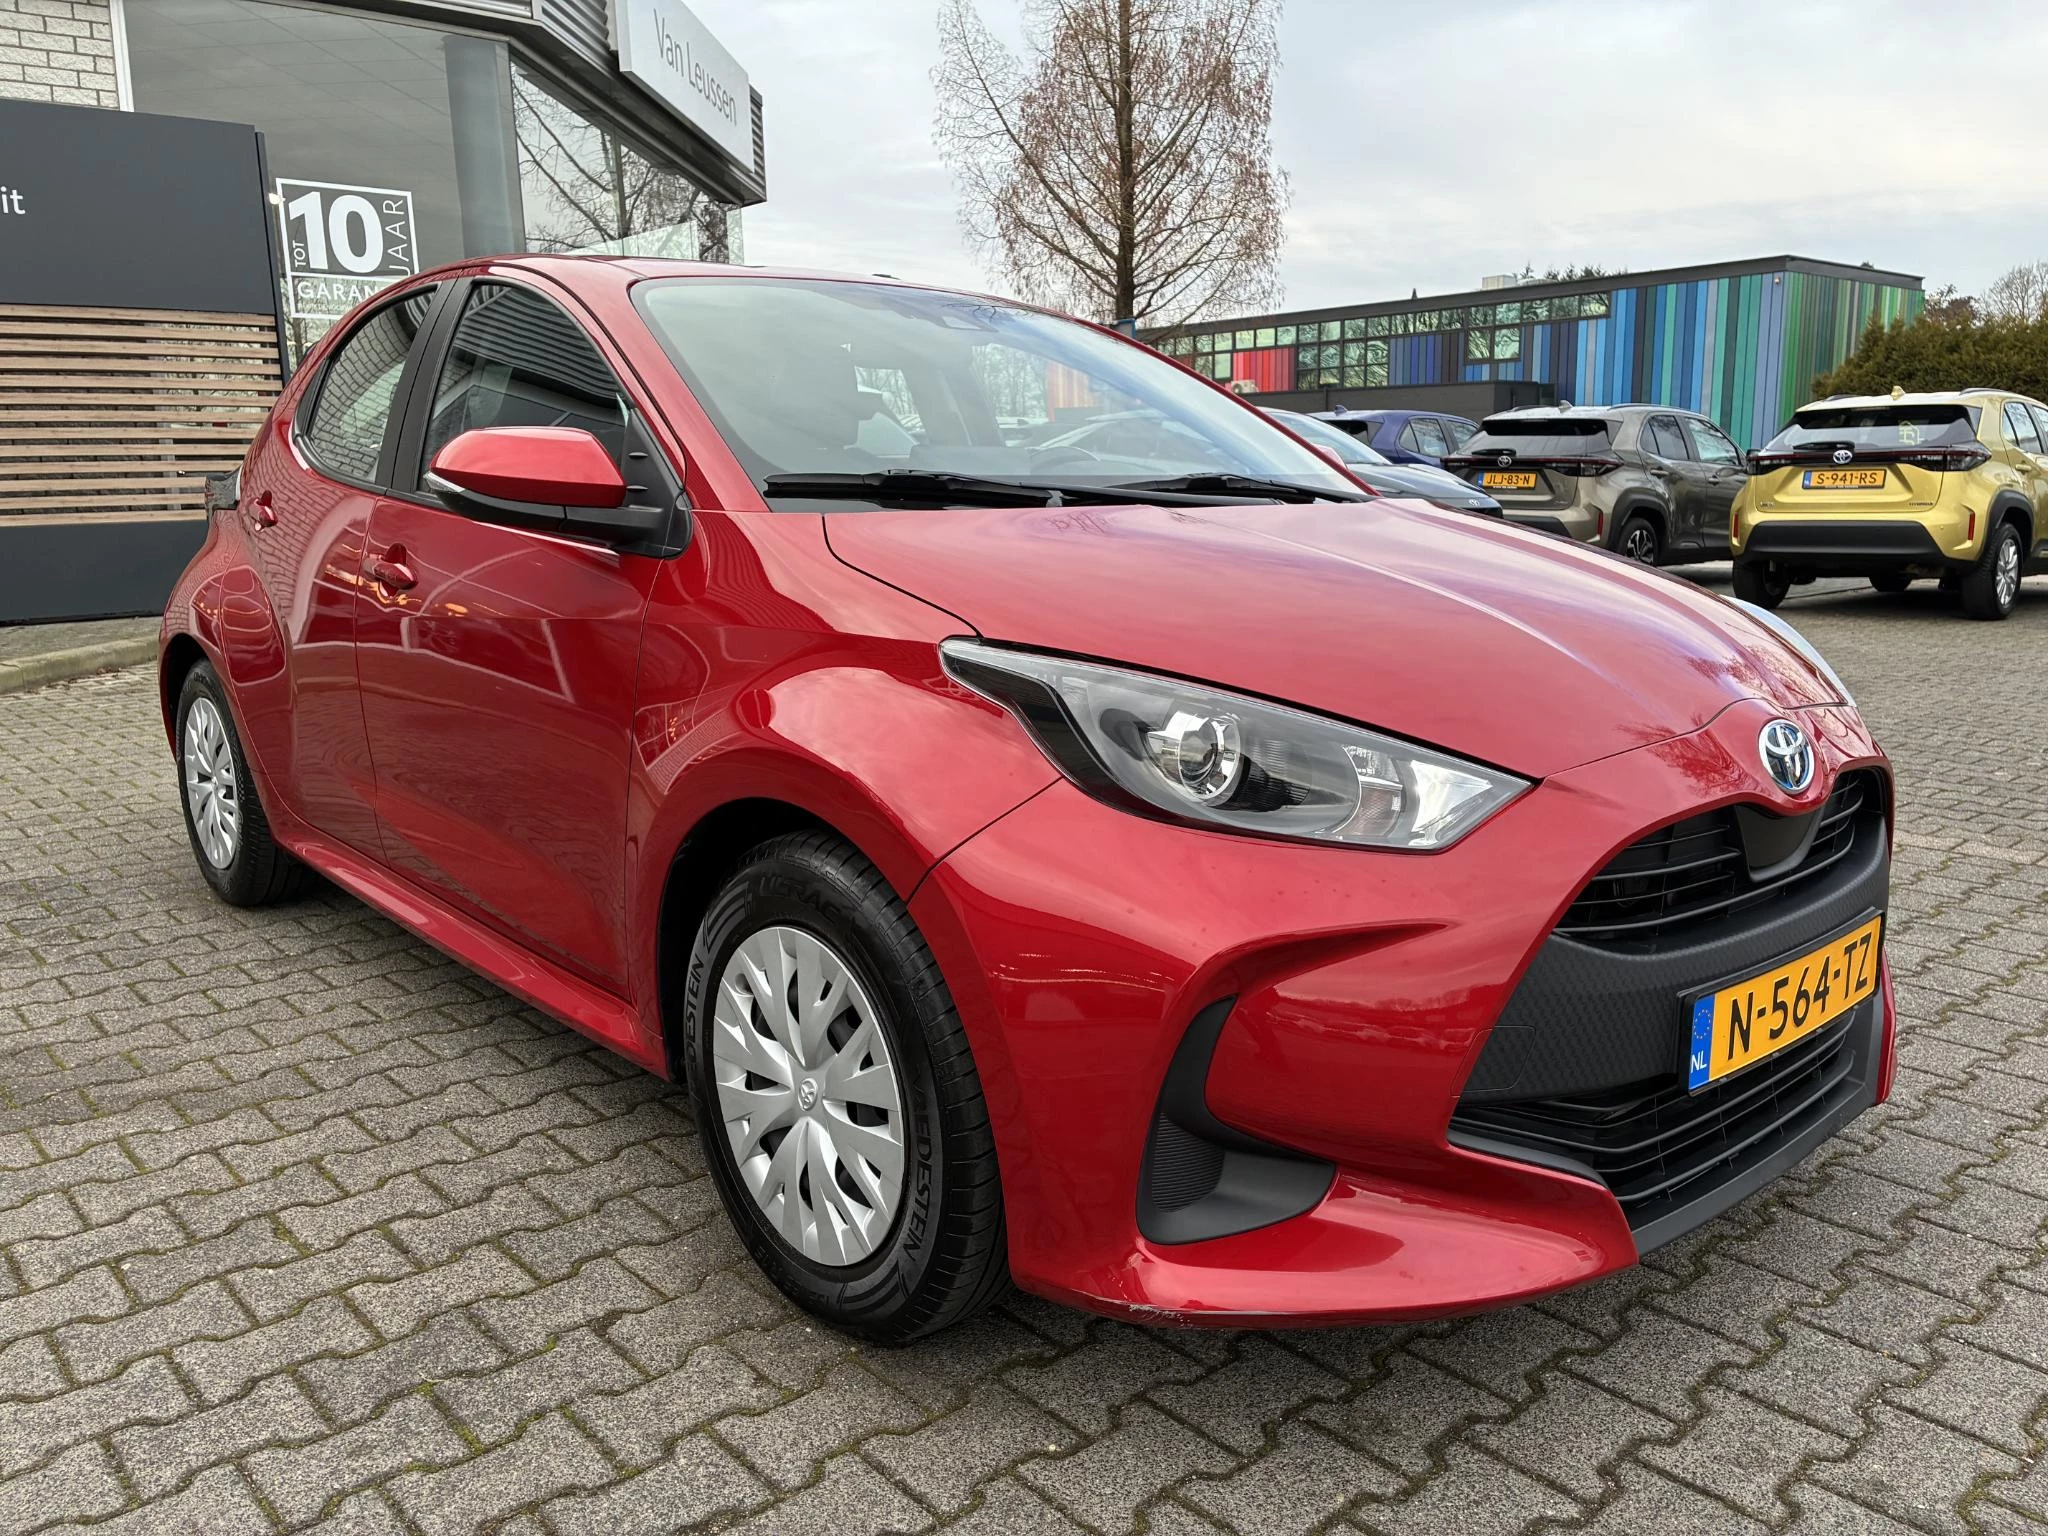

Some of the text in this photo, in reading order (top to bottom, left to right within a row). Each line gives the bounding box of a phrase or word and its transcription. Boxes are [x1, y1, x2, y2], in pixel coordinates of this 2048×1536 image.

[653, 8, 737, 126] Van Leussen
[288, 191, 410, 277] TOT 10 JAAR
[298, 281, 383, 302] GARAN
[1486, 474, 1530, 485] JLJ-83-N
[1816, 472, 1878, 485] S-941-RS
[1727, 931, 1872, 1061] N-564-TZ
[1690, 1050, 1707, 1073] NL
